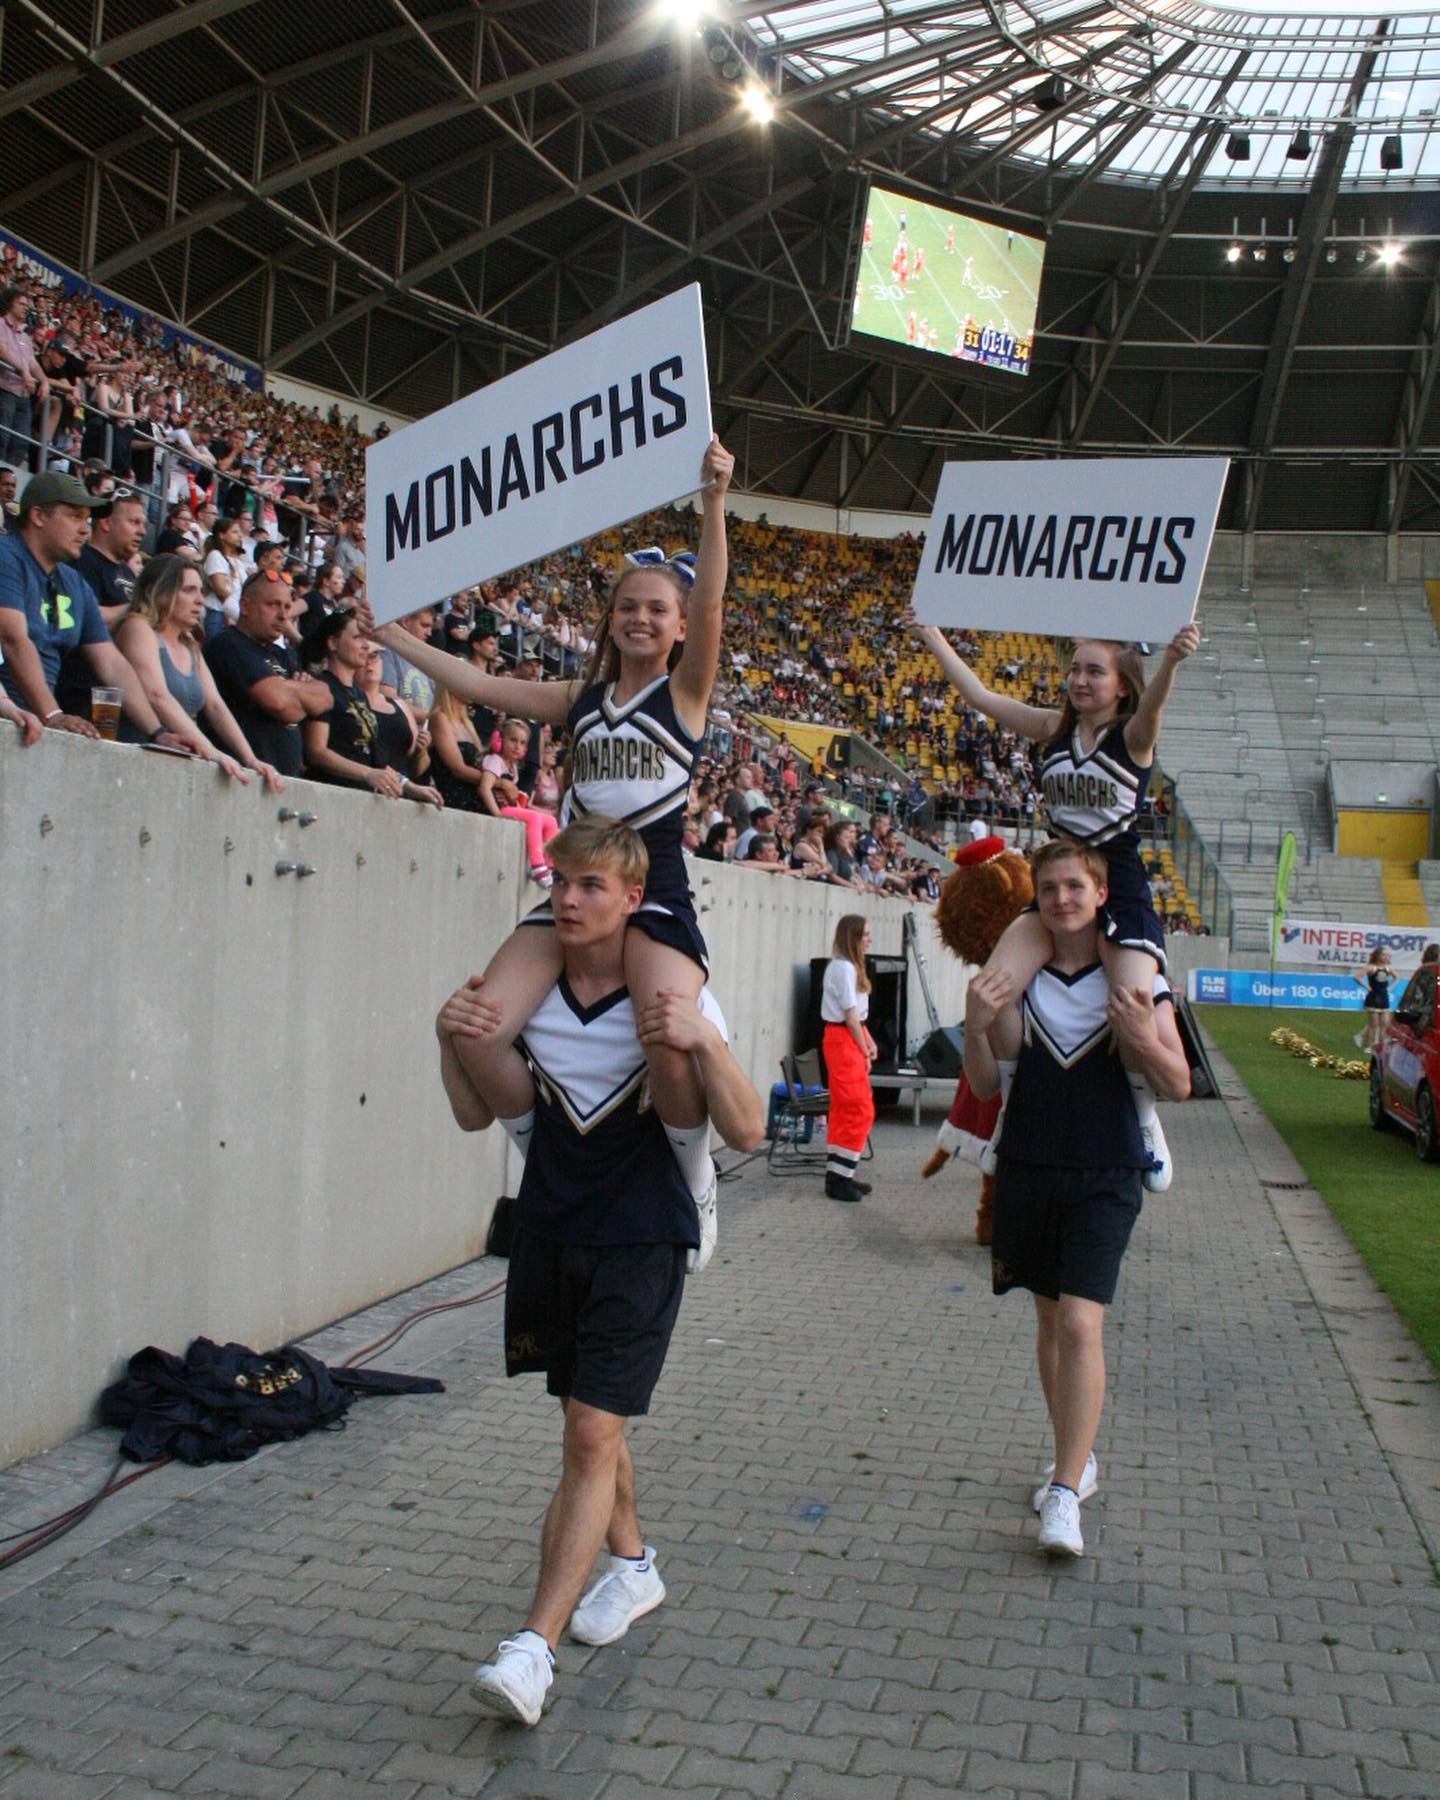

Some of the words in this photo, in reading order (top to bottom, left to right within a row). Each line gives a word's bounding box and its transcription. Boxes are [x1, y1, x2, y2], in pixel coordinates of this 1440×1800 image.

[964, 331, 980, 349] 31
[981, 329, 1014, 357] 01:17
[1013, 344, 1029, 361] 34
[385, 355, 688, 562] MONARCHS
[934, 514, 1196, 584] MONARCHS
[1302, 927, 1428, 951] INTERSPORT
[1252, 980, 1287, 997] Über
[1291, 985, 1318, 999] 180
